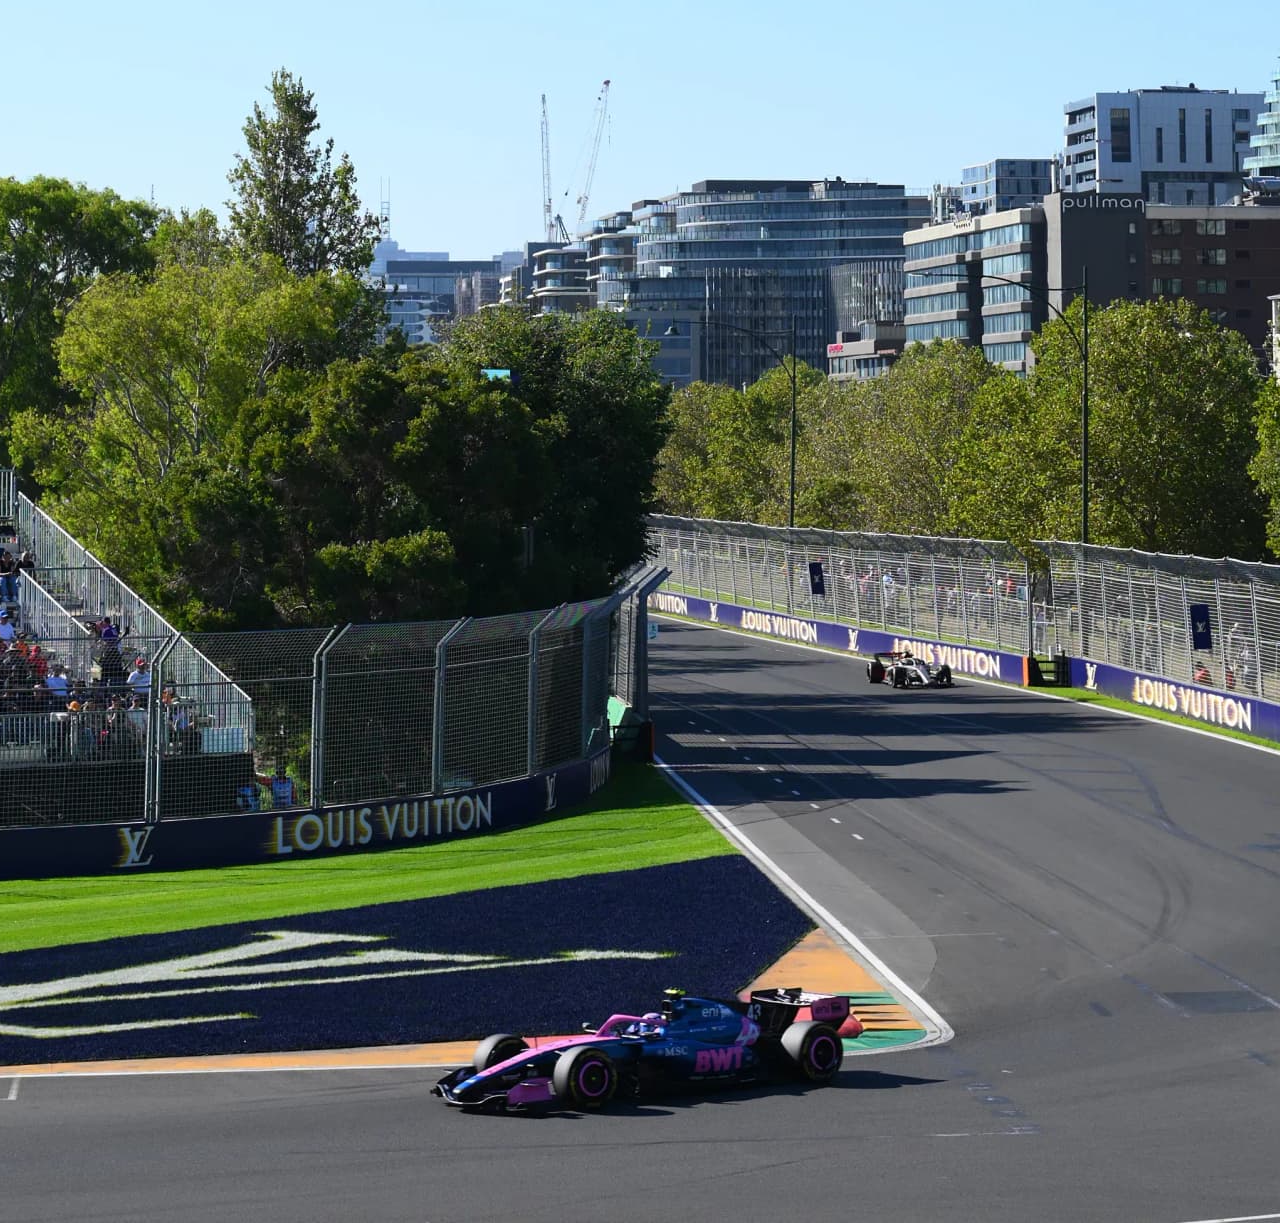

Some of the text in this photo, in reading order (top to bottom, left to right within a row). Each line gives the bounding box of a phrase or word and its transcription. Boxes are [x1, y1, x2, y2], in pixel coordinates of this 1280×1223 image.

[1062, 195, 1145, 213] pullman
[654, 592, 688, 616] VUITTON
[742, 610, 818, 643] LOUIS VUITTON
[937, 644, 1001, 679] VUITTON
[1133, 676, 1252, 732] LOUIS VUITTON
[277, 792, 492, 854] LOUIS VUITTON
[702, 1007, 719, 1017] eni
[664, 1046, 688, 1057] MSC
[695, 1045, 744, 1073] BWT
